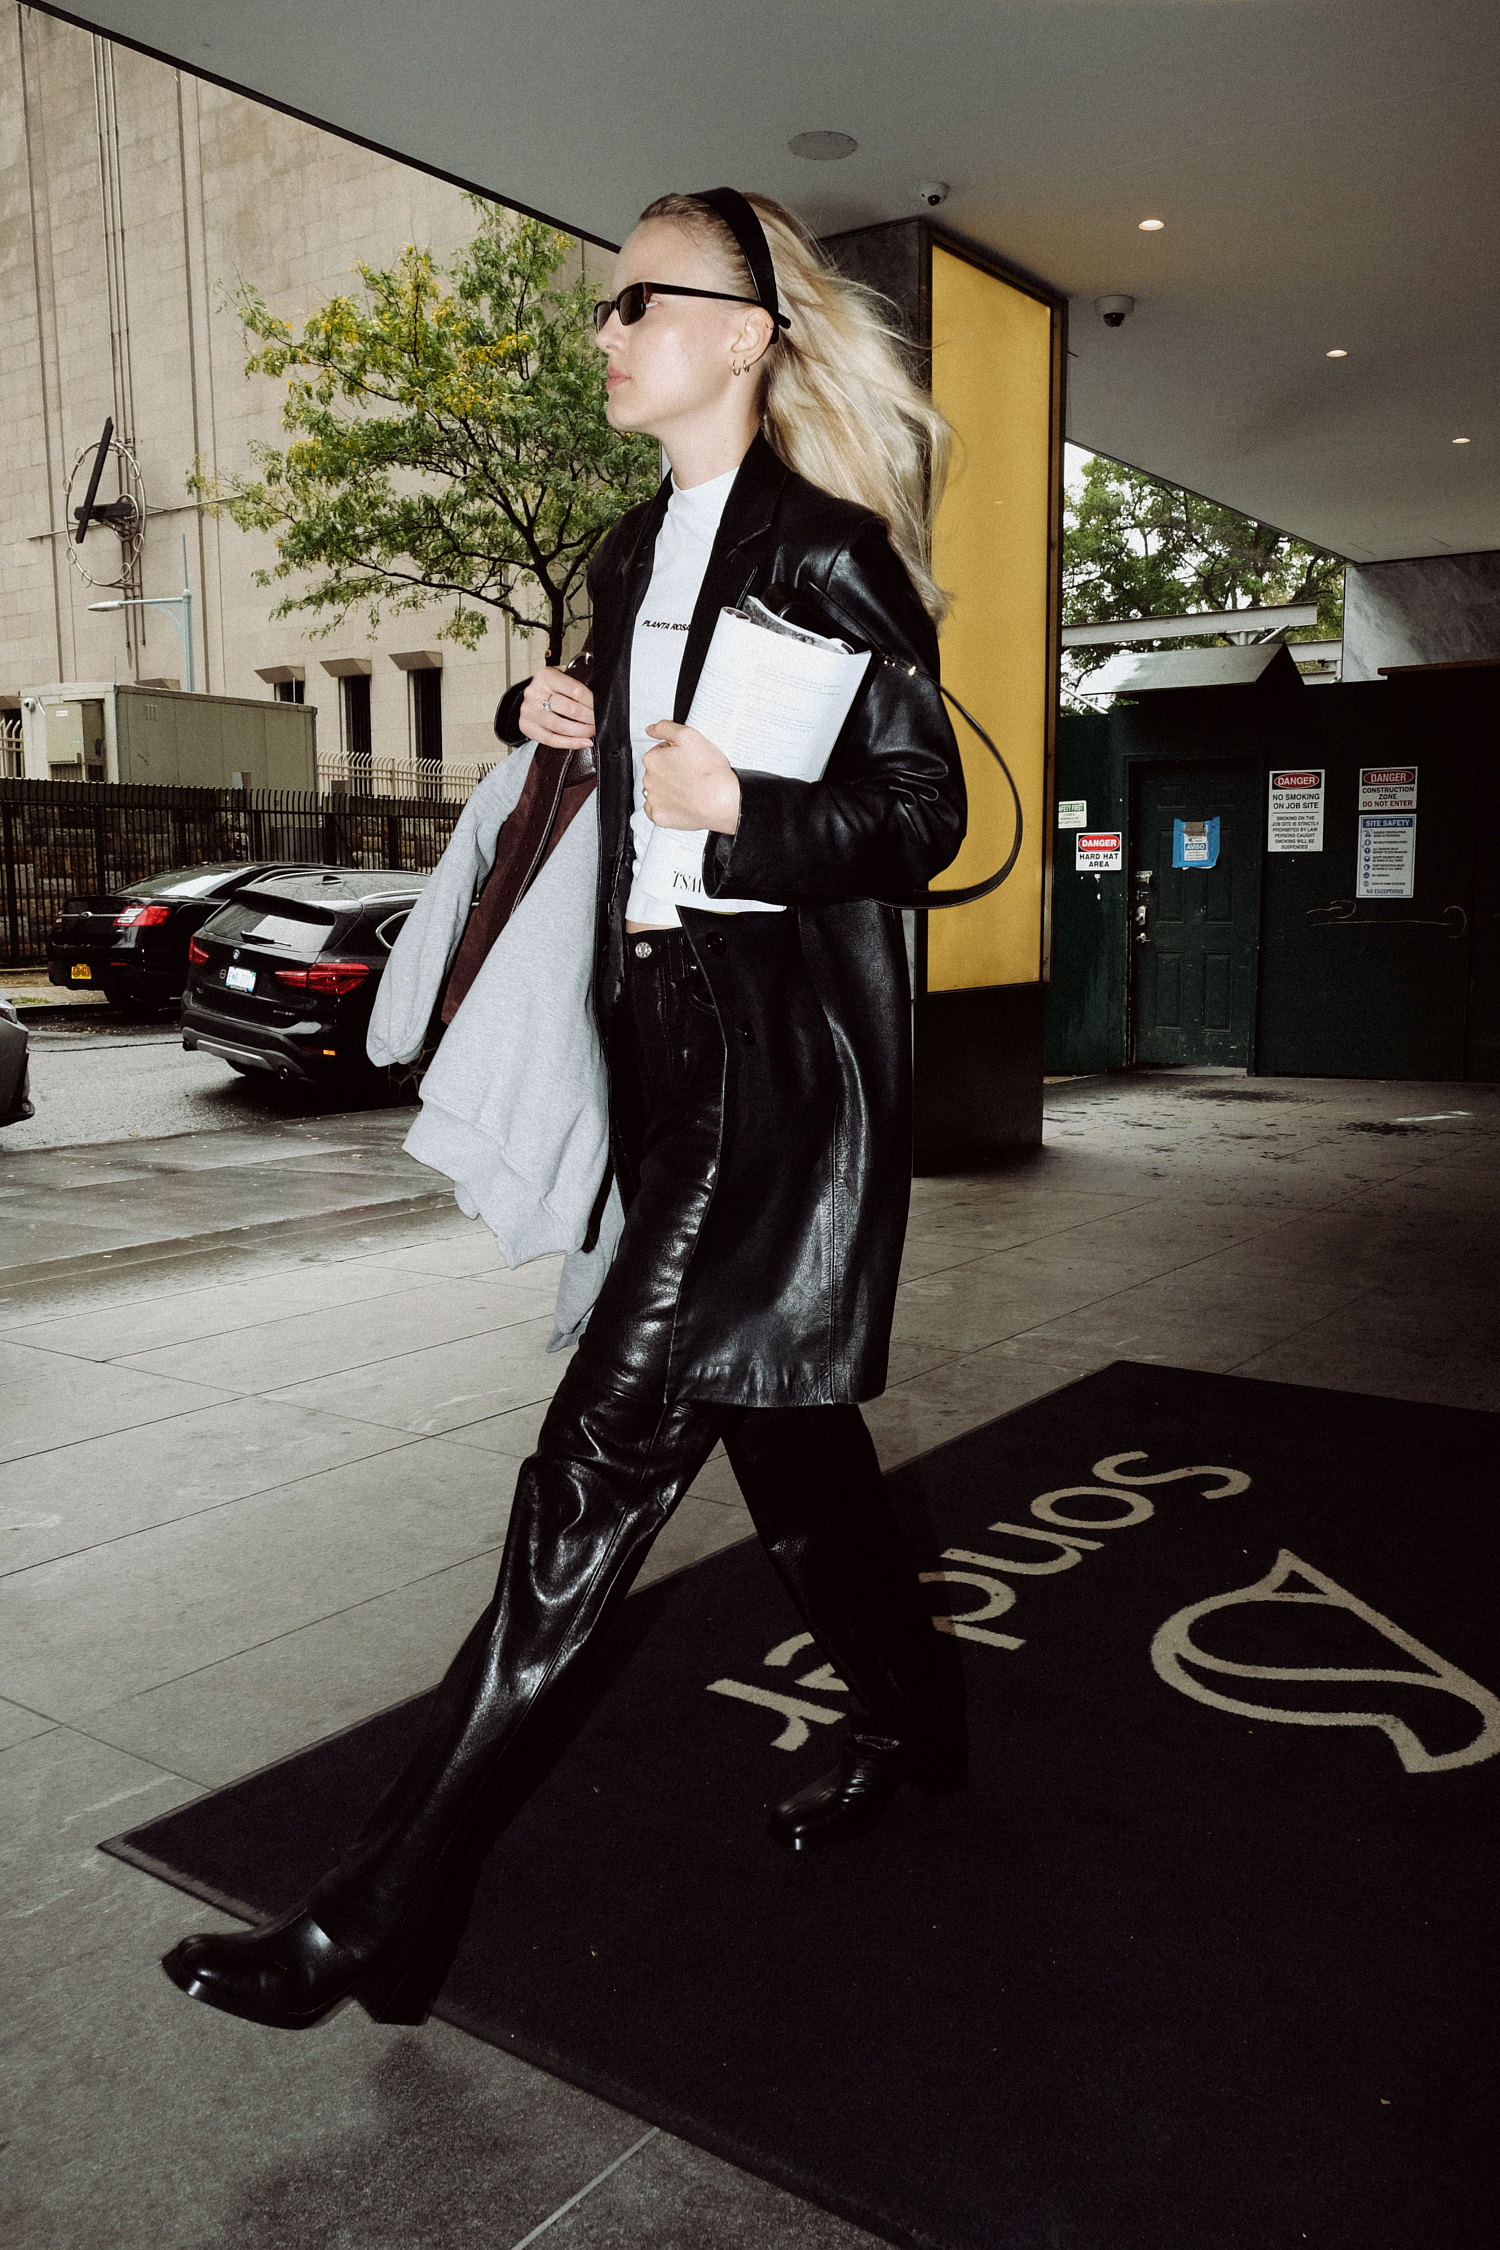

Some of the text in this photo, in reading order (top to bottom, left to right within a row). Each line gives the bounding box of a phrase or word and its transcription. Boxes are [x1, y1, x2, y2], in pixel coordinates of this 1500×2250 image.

[642, 620, 691, 631] PLANTA ROSA
[1278, 776, 1315, 785] DANGER
[1370, 773, 1406, 782] DANGER
